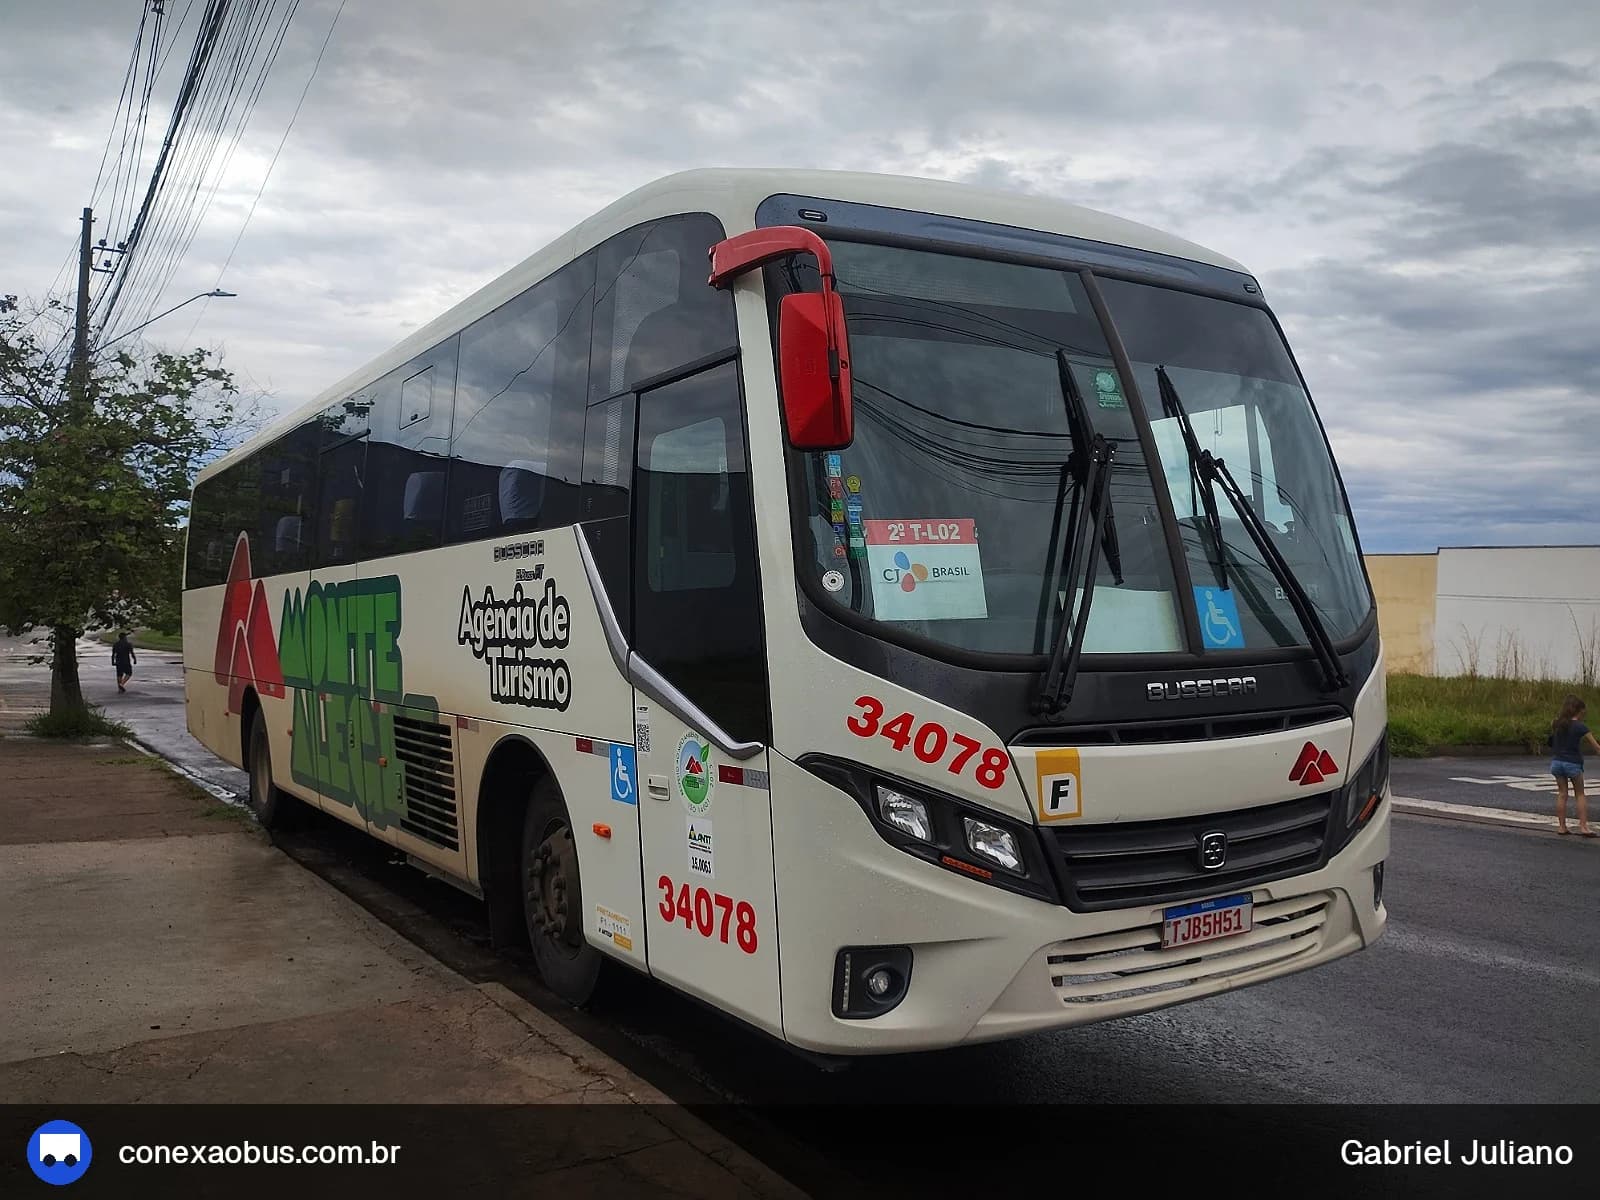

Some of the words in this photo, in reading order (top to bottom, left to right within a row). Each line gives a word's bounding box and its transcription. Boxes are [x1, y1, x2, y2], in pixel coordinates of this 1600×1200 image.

[888, 523, 906, 541] 2º
[910, 523, 961, 541] T-L02
[494, 540, 545, 562] BUSSCAR
[883, 568, 900, 582] CJ
[932, 566, 970, 578] BRASIL
[278, 575, 402, 697] MONTE
[459, 585, 537, 658] Agência
[538, 579, 570, 649] de
[487, 647, 571, 711] Turismo
[1147, 676, 1257, 701] BUSSCAR
[847, 695, 1010, 790] 34078
[1050, 778, 1070, 810] F
[658, 875, 758, 955] 34078
[1171, 908, 1244, 944] TJB5H51
